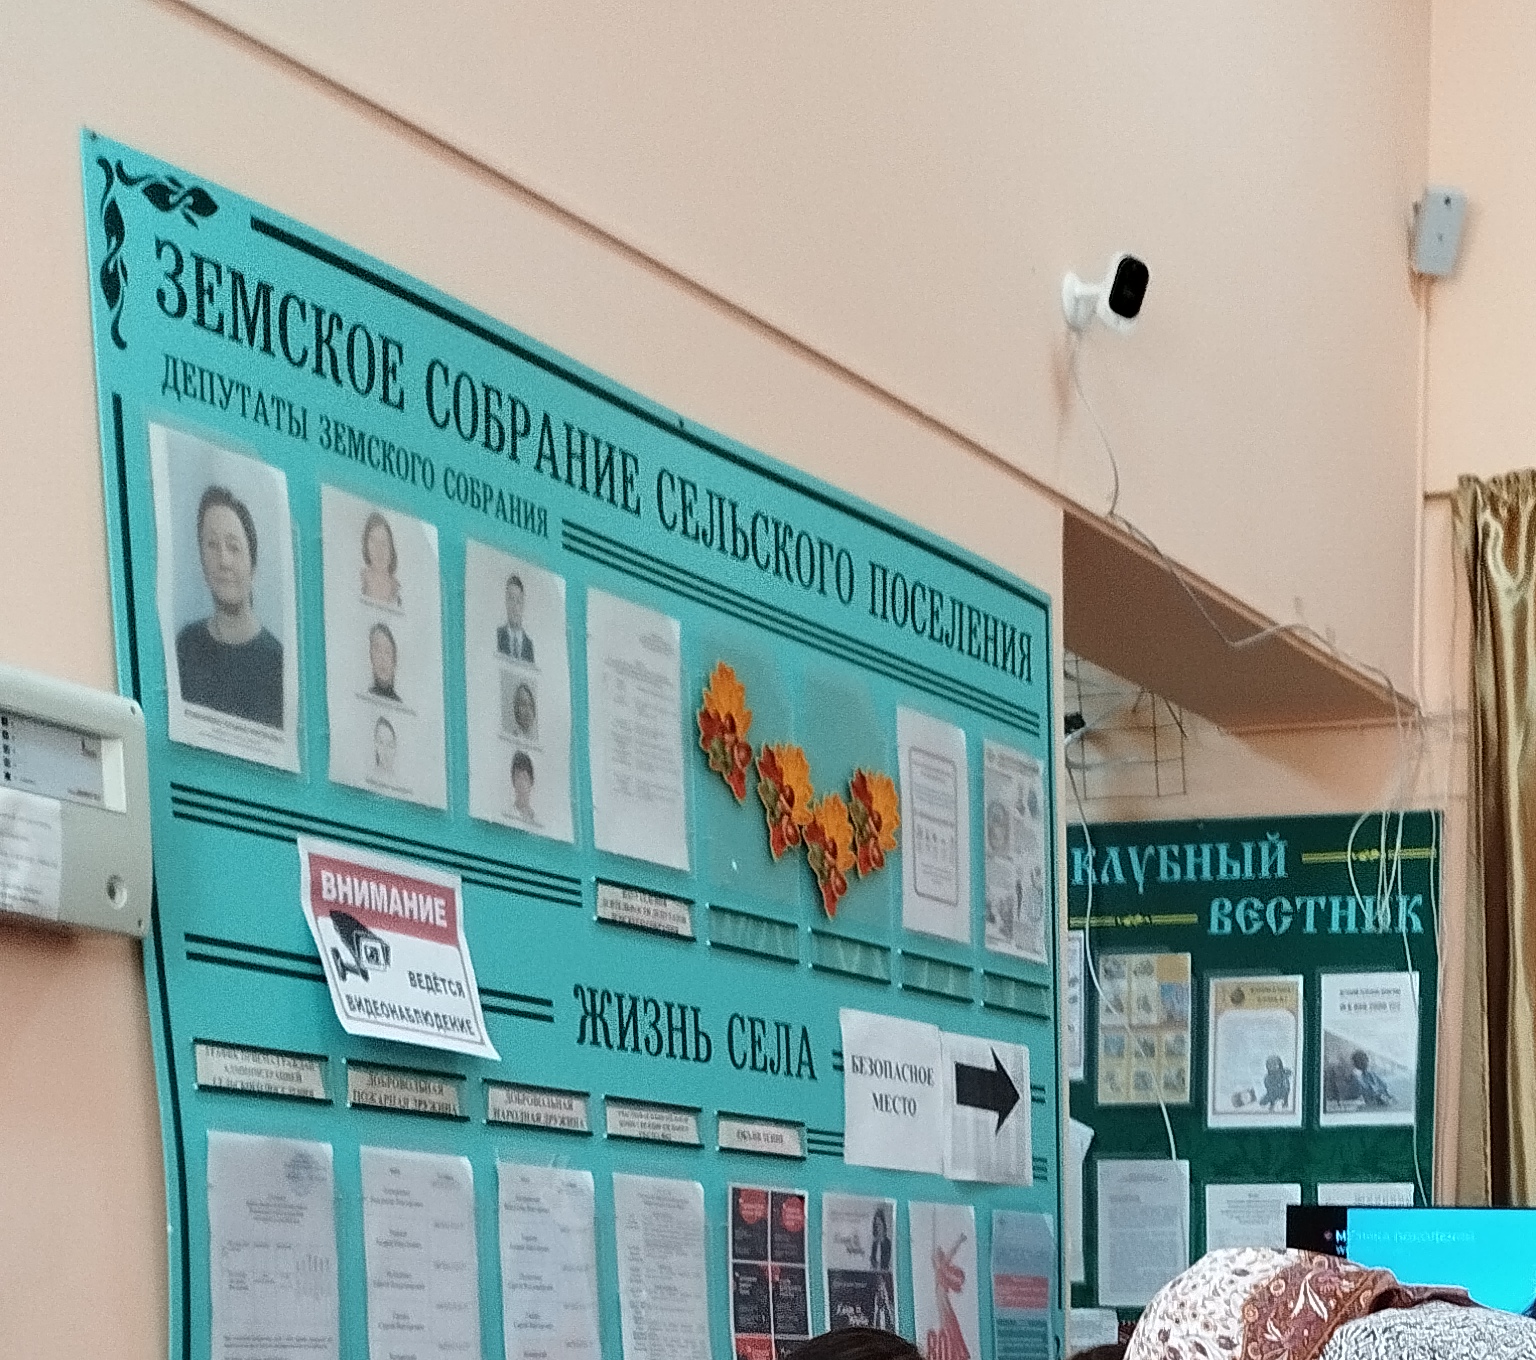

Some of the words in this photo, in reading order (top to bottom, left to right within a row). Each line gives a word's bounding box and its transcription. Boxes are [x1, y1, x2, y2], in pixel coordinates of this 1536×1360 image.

[155, 234, 406, 411] ЗЕМСКОЕ
[425, 357, 643, 518] СОБРАНИЕ
[656, 467, 856, 608] СЕЛЬСКОГО
[868, 560, 1033, 683] ПОСЕЛЕНИЯ
[161, 353, 309, 441] ДЕПУТАТЫ
[319, 414, 436, 491] ЗЕМСКОГО
[443, 466, 549, 539] СОБРАНИЯ
[1071, 830, 1289, 896] КЛУБНЫЙ
[320, 868, 448, 928] ВНИМАНИЕ
[1207, 893, 1425, 936] ВЕСТНИК
[407, 970, 466, 999] ВЕДЁТСЯ
[345, 994, 475, 1037] ВИДЕОНАБЛЮДЕНИЕ
[573, 984, 713, 1064] ЖИЗНЬ
[727, 1012, 818, 1081] СЕЛА
[850, 1053, 935, 1088] БЕЗОПАСНОЕ
[871, 1091, 917, 1117] МЕСТО
